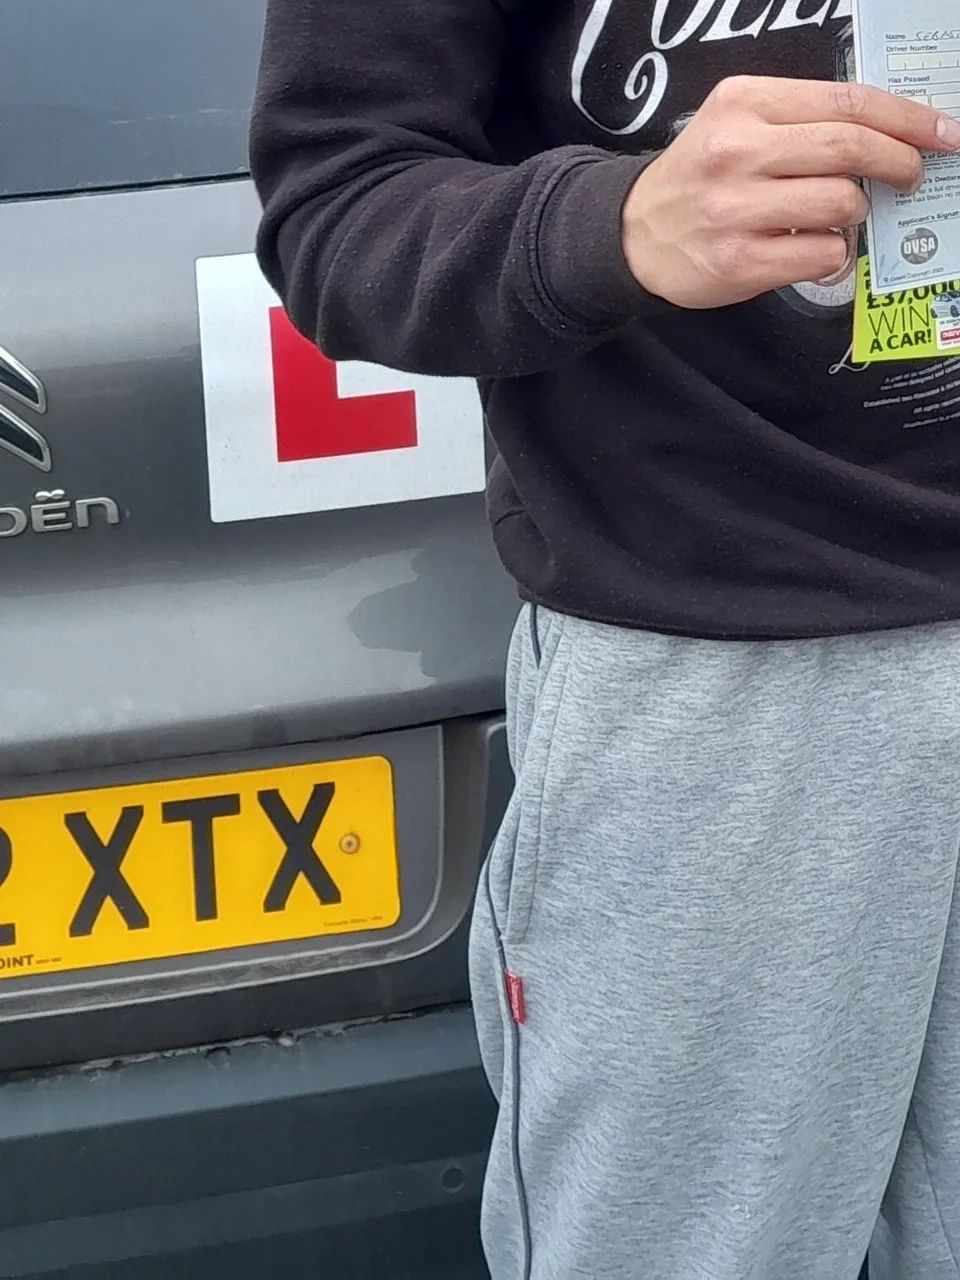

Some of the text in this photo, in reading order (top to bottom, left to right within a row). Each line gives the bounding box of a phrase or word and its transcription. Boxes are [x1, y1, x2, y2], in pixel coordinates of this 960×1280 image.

[868, 303, 930, 336] WIN
[869, 338, 883, 353] A
[887, 329, 932, 350] CAR!
[269, 306, 418, 462] L
[64, 782, 342, 938] XTX
